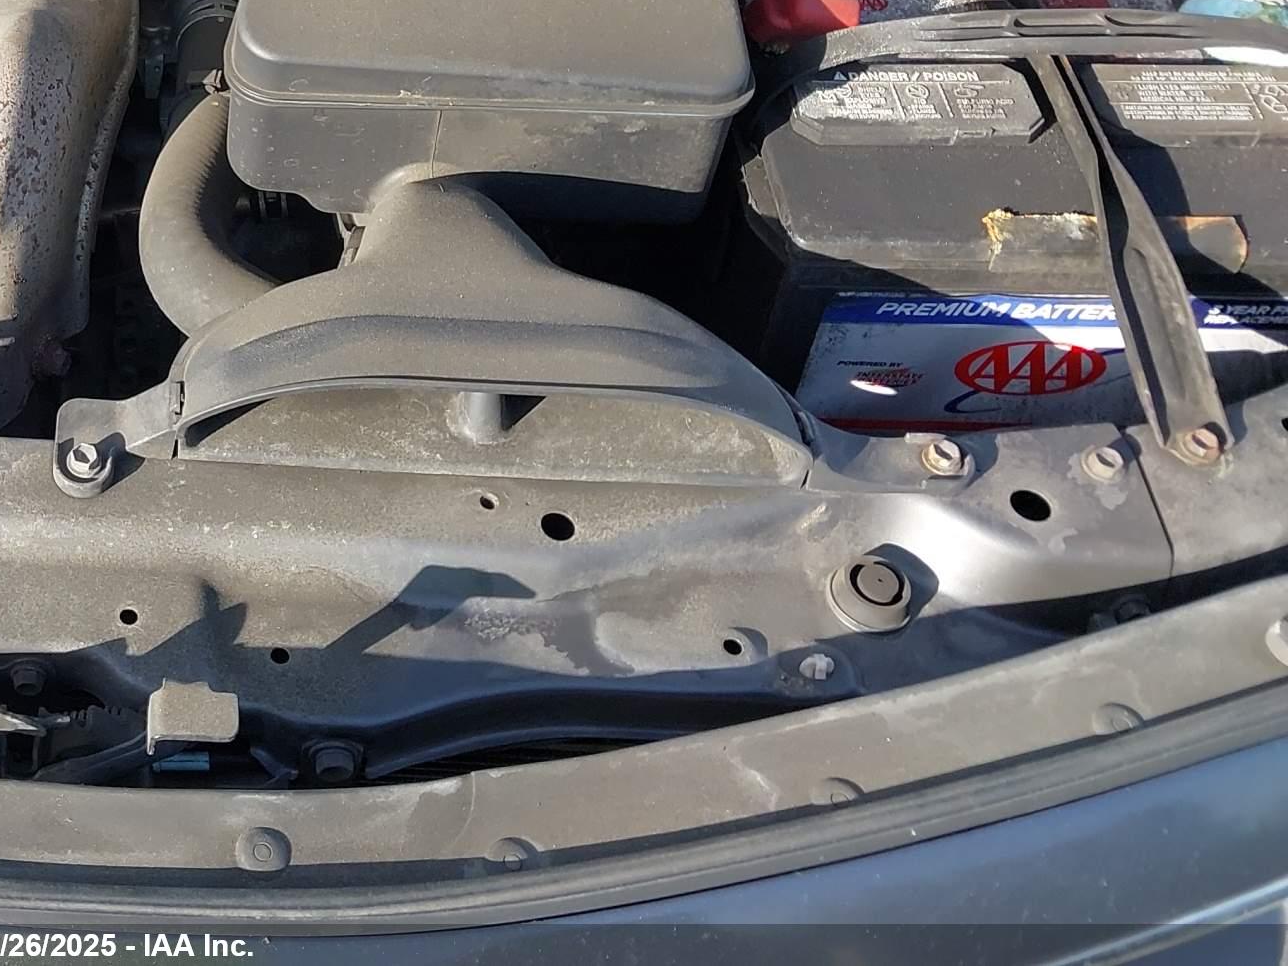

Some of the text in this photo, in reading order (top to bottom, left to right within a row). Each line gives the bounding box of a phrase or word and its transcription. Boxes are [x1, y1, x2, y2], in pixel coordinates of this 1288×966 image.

[848, 71, 910, 82] DANGER
[923, 72, 979, 82] POISON
[875, 301, 1117, 322] PREMIUM BATTER
[1226, 305, 1271, 315] YEAR
[960, 342, 1100, 394] AAA
